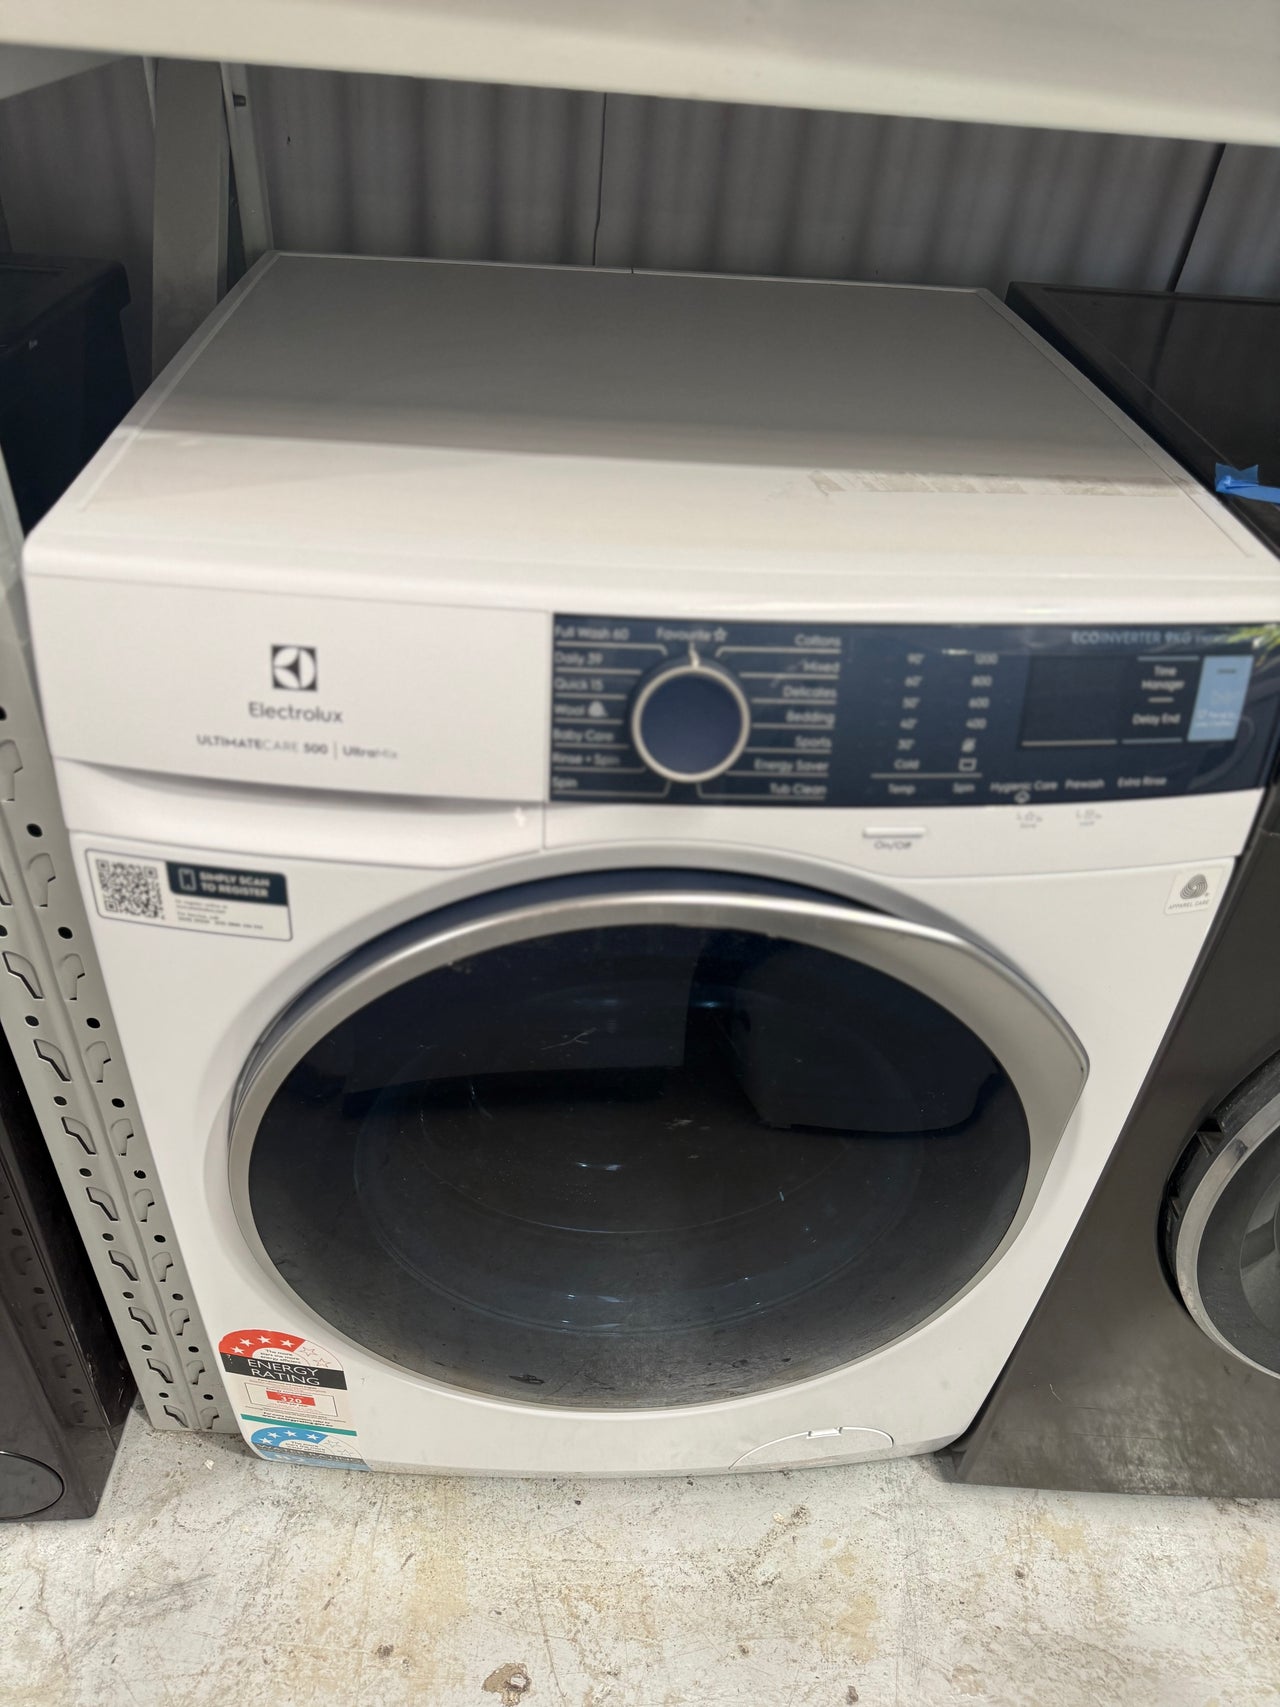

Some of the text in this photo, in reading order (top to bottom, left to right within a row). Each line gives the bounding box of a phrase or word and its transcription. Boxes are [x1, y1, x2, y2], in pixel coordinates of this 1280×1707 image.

[554, 626, 575, 638] Full
[577, 627, 610, 640] Wash
[656, 627, 712, 641] Favourite
[1071, 630, 1160, 644] ECOINVERTER
[795, 634, 841, 646] Cottons
[554, 652, 584, 666] Daily
[803, 661, 840, 673] Mixed
[1154, 666, 1177, 676] Time
[554, 678, 588, 690] Quick
[1141, 680, 1185, 693] Manager
[783, 685, 837, 698] Delicates
[249, 701, 343, 723] Electrolux
[786, 710, 835, 726] Bedding
[1132, 713, 1180, 726] Delay End
[553, 728, 614, 742] Baby Care
[197, 734, 328, 755] ULTIMATECARE 500
[795, 735, 831, 750] Sports
[552, 752, 583, 764] Rinse
[594, 754, 620, 766] Spin
[754, 758, 829, 773] Energy Saver
[894, 759, 920, 770] Cold
[552, 776, 578, 788] Spin
[990, 780, 1058, 793] Hygienic Care
[1065, 779, 1104, 789] Prewash
[1117, 776, 1167, 787] Extra Rinse
[770, 782, 827, 795] Tub Clean
[888, 783, 916, 795] Temp
[953, 783, 975, 794] Spin
[874, 840, 912, 851] On/Off
[200, 872, 270, 887] SIMPLY SCAN
[202, 883, 269, 897] TO REGISTER
[1167, 899, 1209, 910] APPAREL CARE
[248, 1359, 319, 1376] ENERGY
[252, 1368, 320, 1386] RATING
